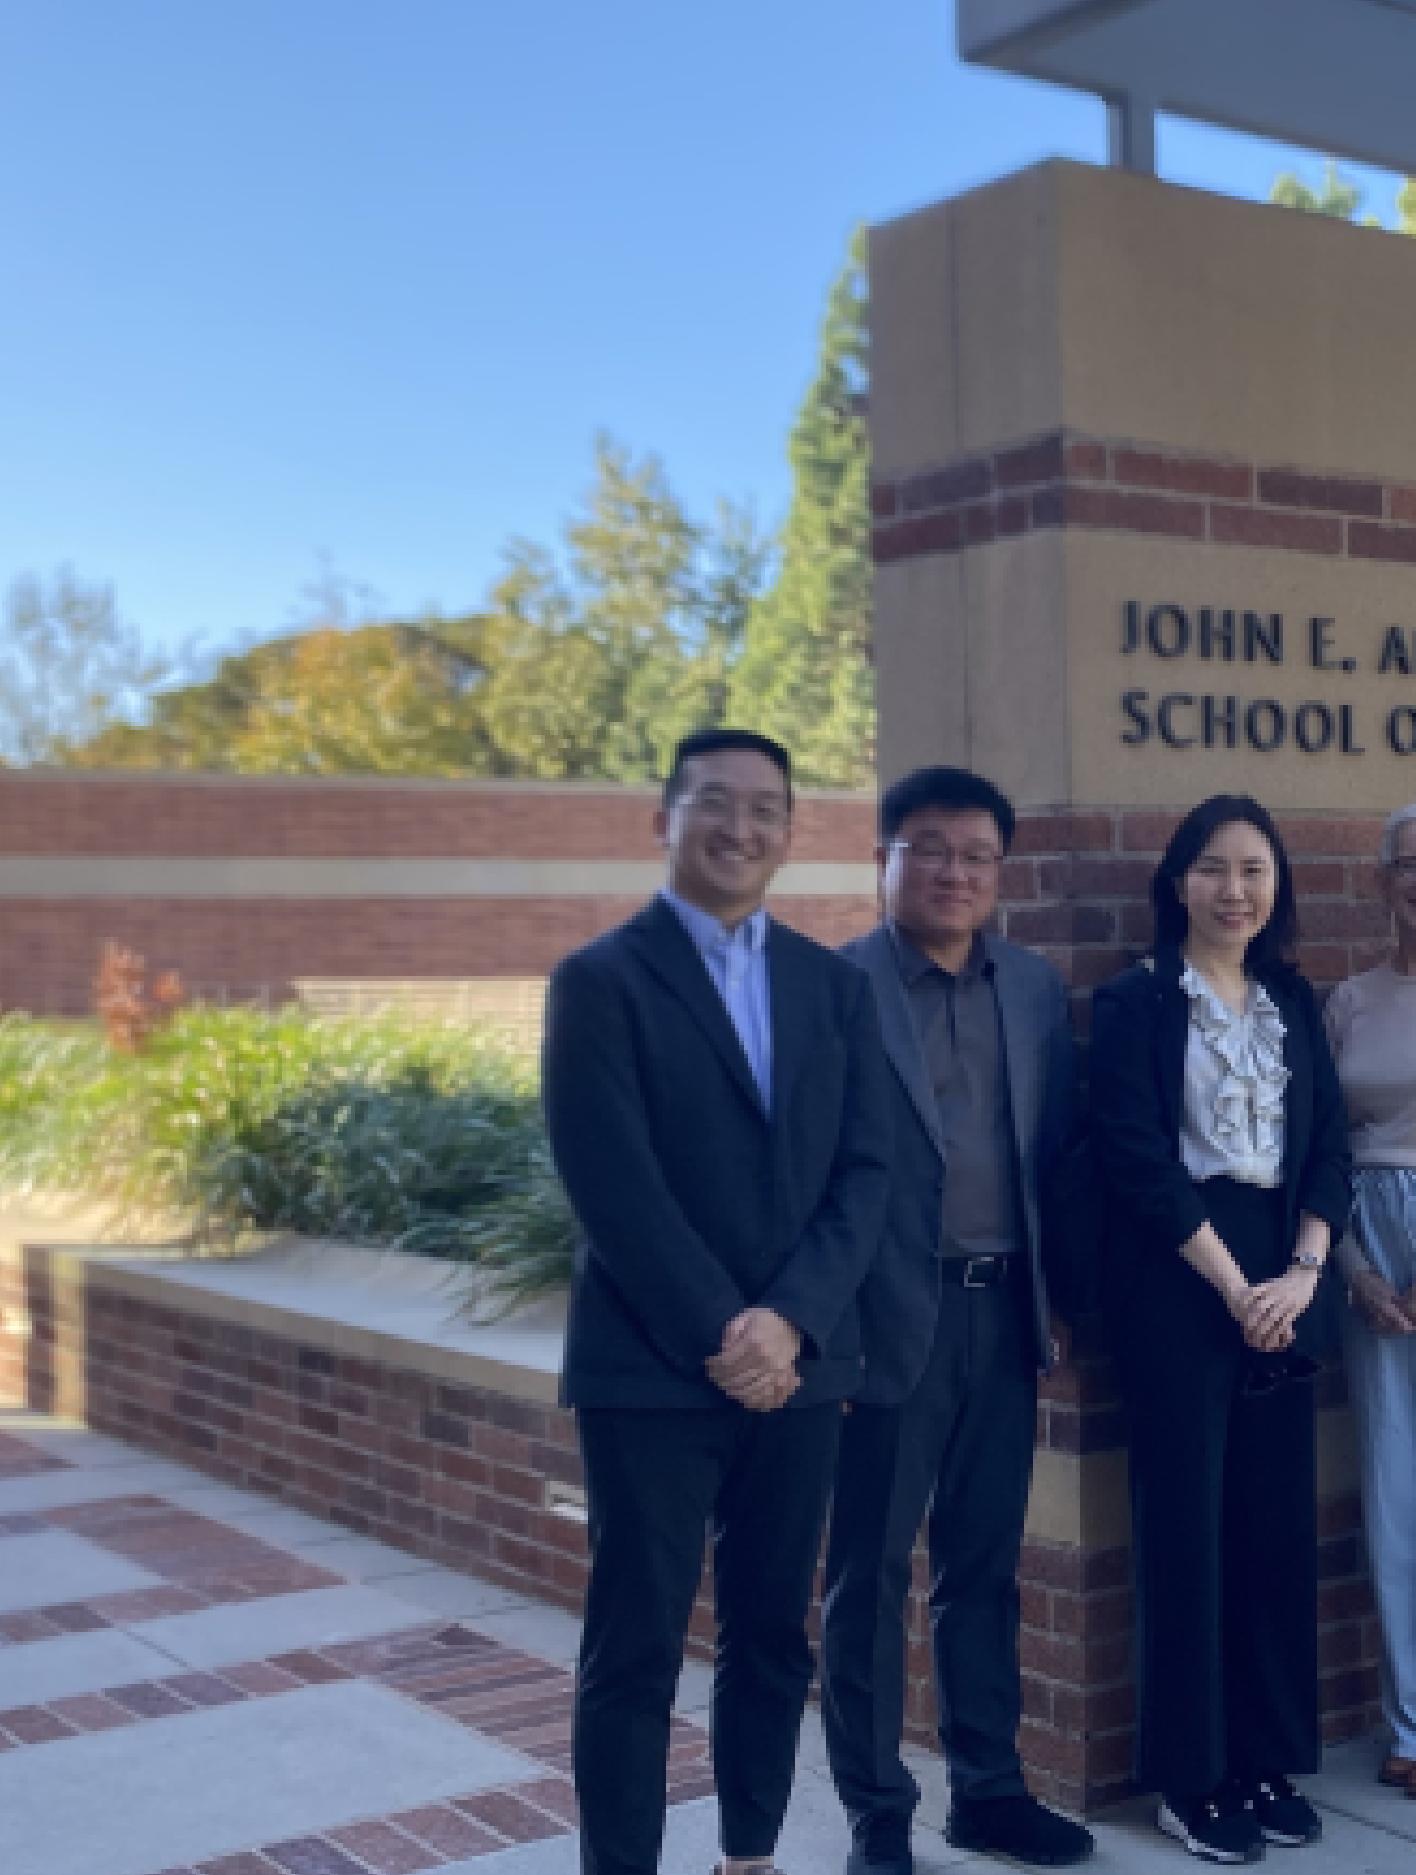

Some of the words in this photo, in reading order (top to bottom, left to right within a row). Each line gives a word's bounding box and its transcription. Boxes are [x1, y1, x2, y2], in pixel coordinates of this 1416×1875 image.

[1119, 600, 1285, 663] JOHN
[1308, 618, 1356, 673] E.
[1119, 689, 1366, 755] SCHOOL
